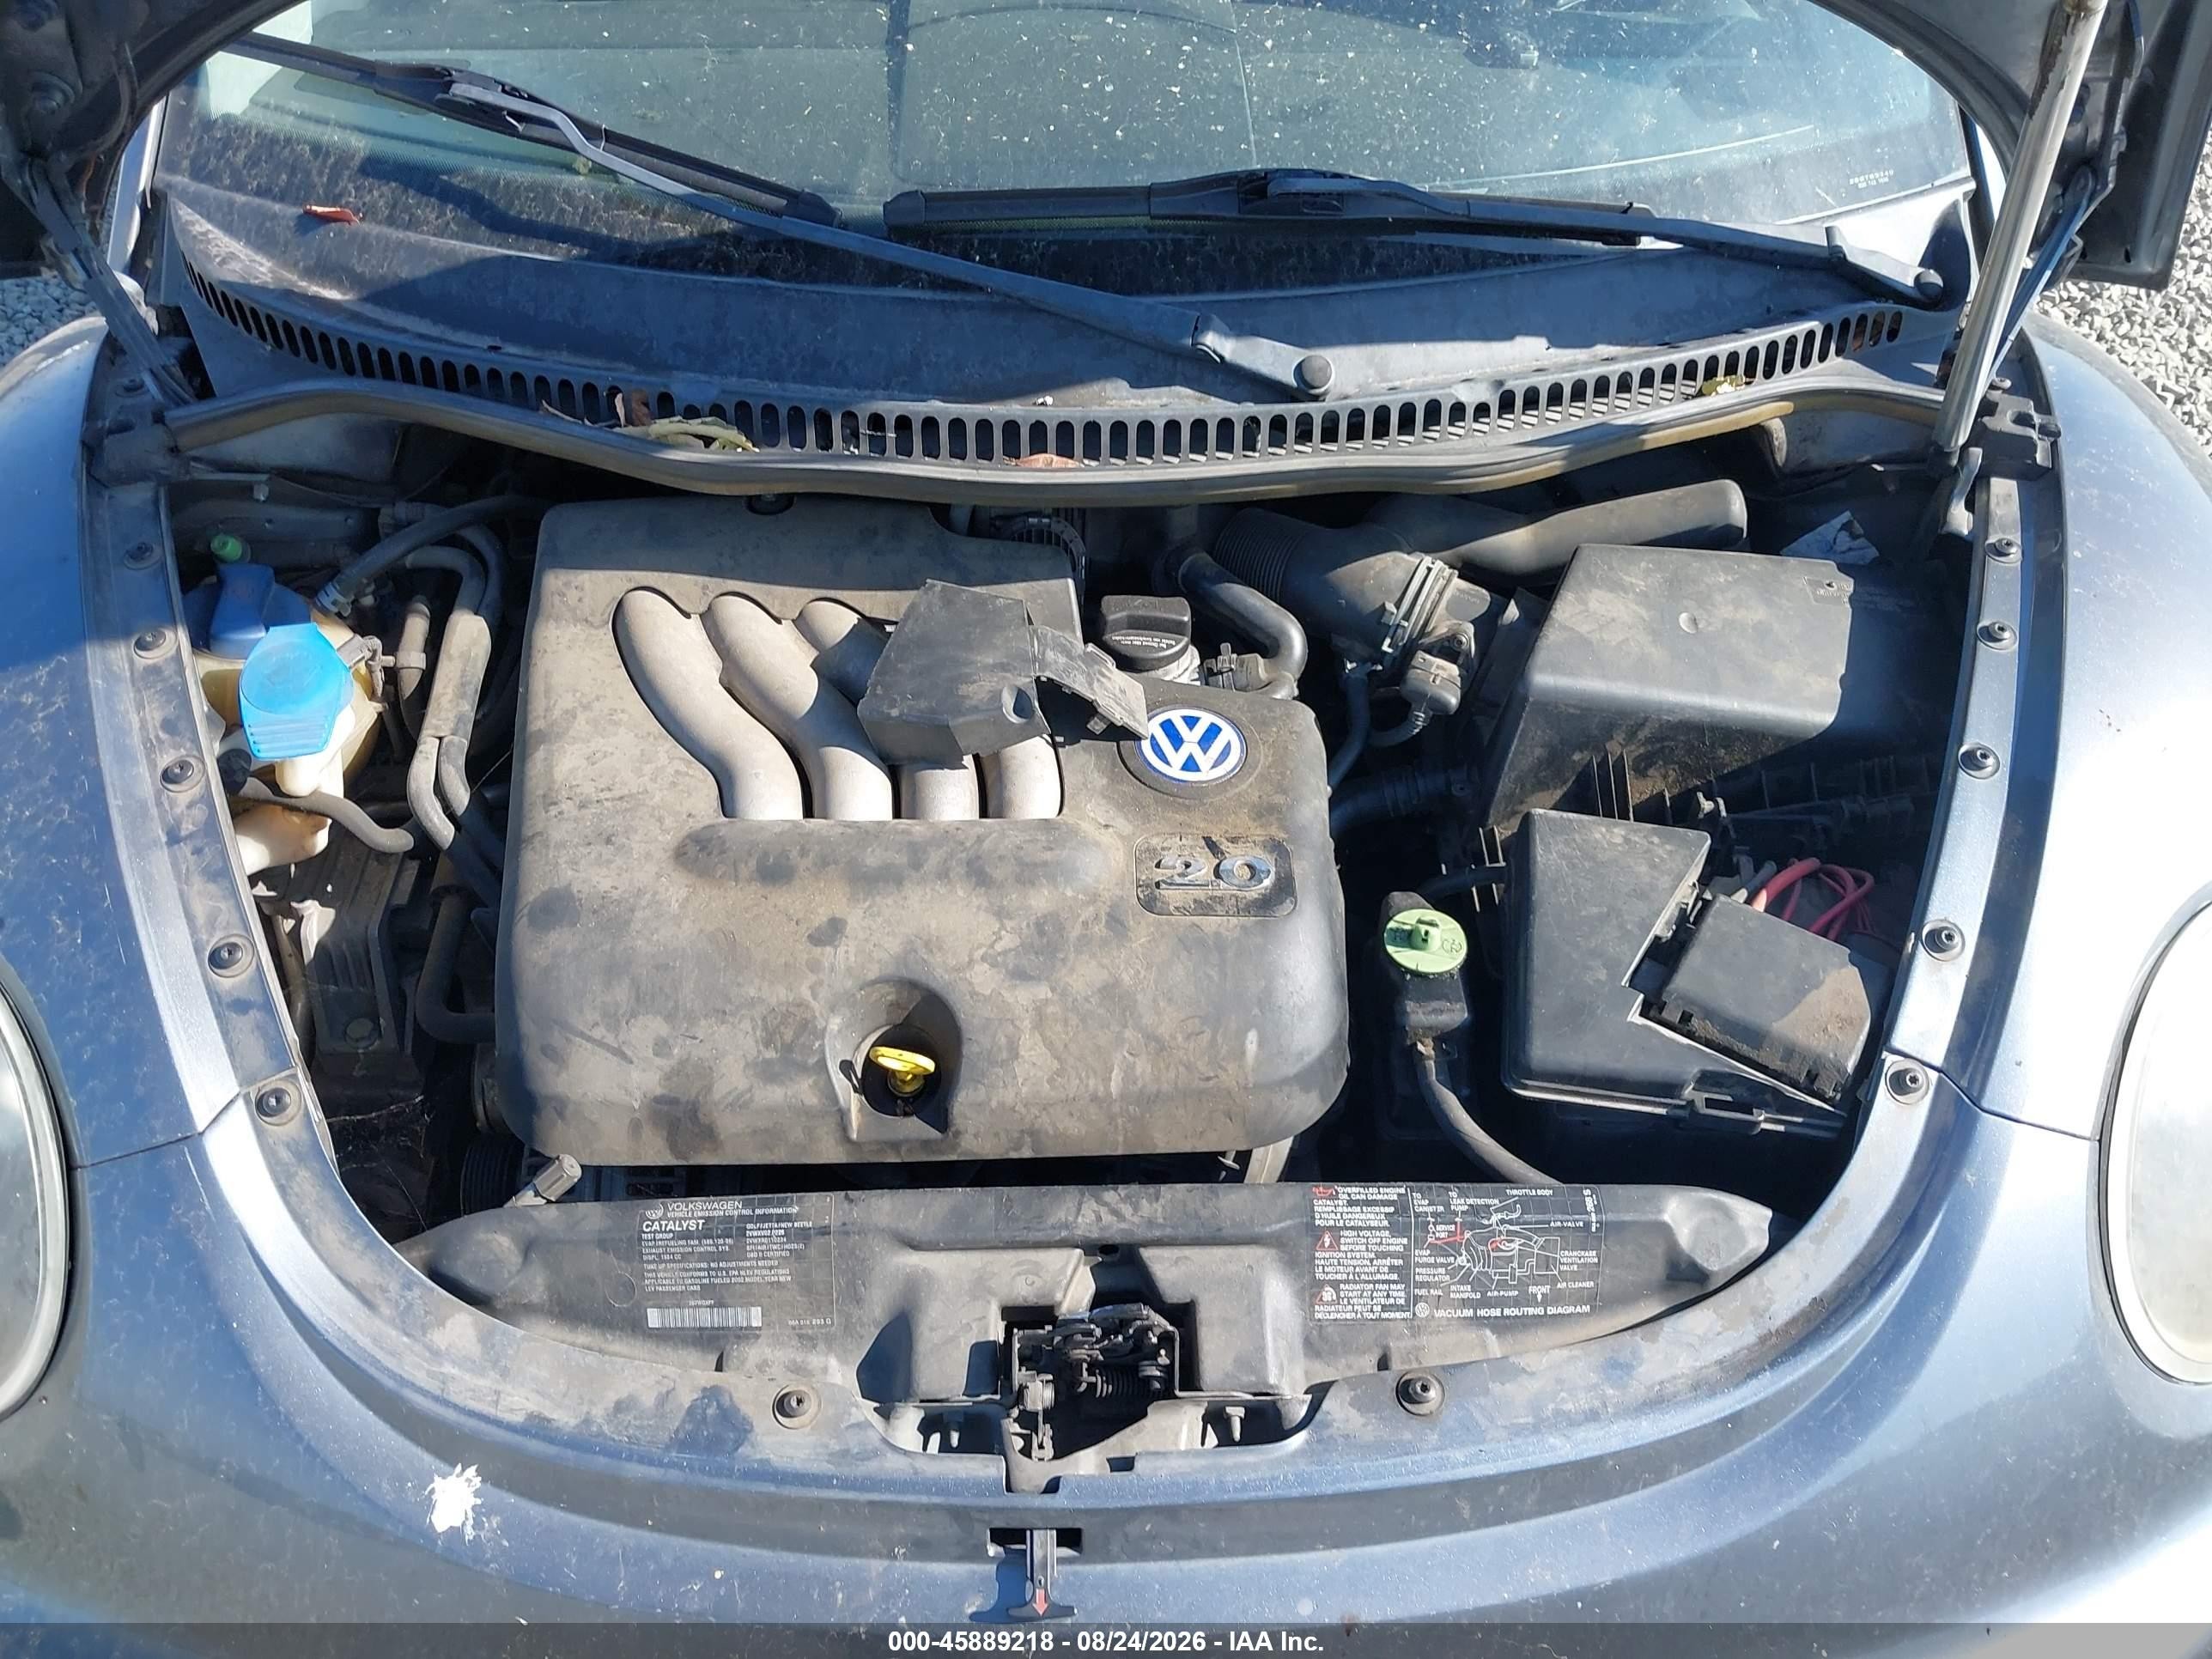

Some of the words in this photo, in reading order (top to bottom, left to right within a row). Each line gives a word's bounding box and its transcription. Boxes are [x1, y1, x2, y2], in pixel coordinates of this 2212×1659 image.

[667, 1200, 743, 1211] VOLKSWAGEN
[642, 1219, 706, 1232] CATALYST
[1372, 1256, 1404, 1266] ARRÊTER
[1528, 1285, 1551, 1294] FRONT
[1434, 1308, 1474, 1317] VACUUM
[1477, 1308, 1502, 1316] HOSE
[1503, 1306, 1544, 1316] ROUTING
[1547, 1304, 1590, 1315] DIAGRAM
